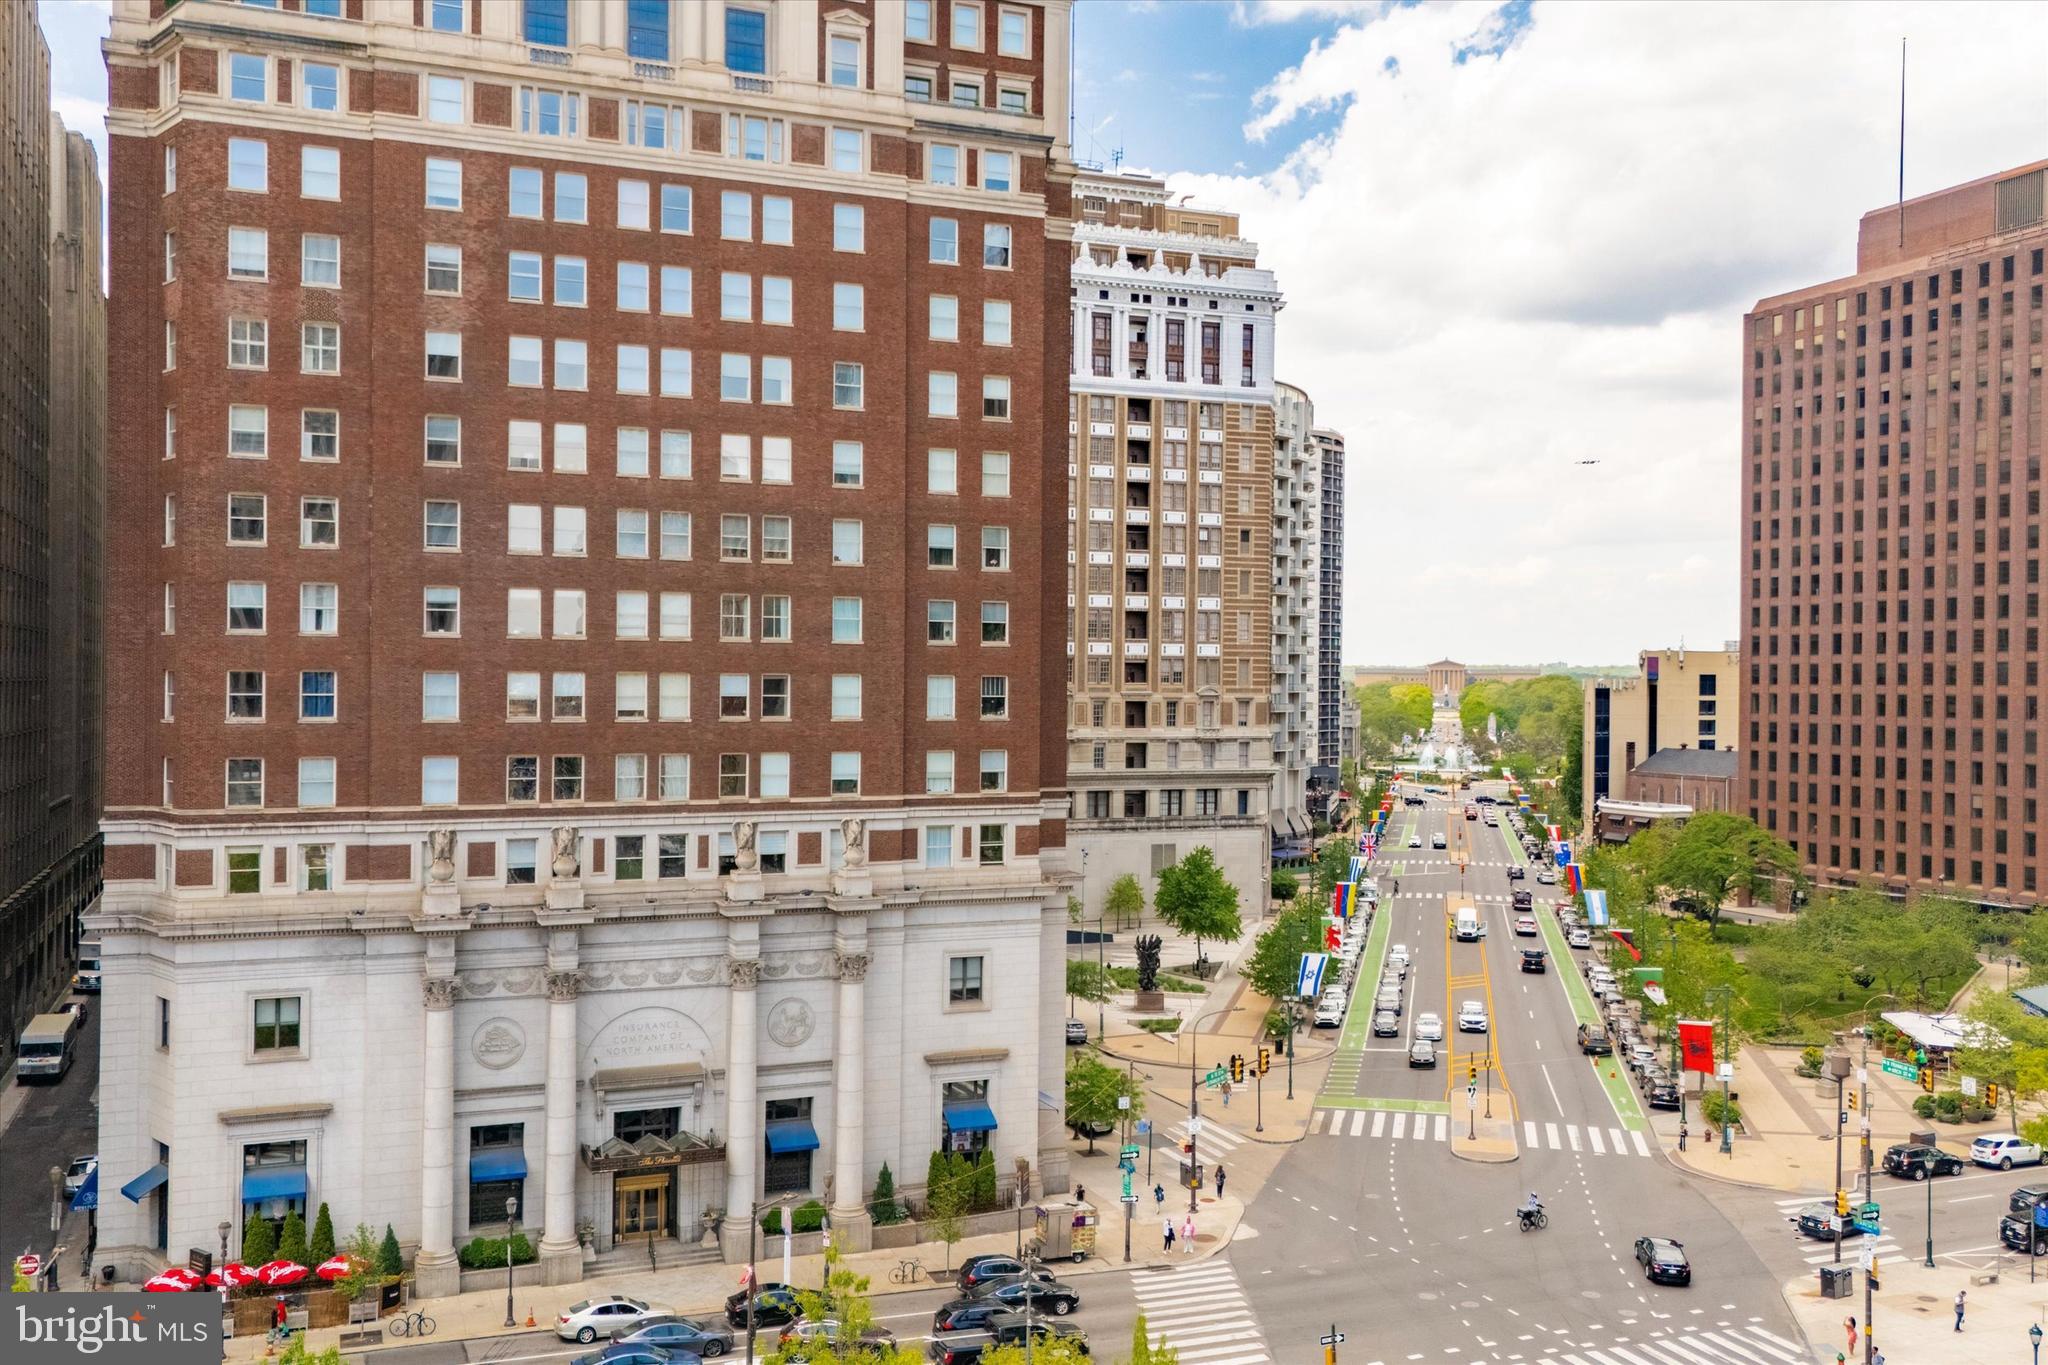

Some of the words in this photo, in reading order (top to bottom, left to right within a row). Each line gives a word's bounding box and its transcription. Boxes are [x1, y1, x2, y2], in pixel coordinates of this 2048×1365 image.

[619, 1020, 680, 1032] INSURANCE
[613, 1032, 665, 1045] COMPANY
[670, 1031, 683, 1040] OF
[606, 1046, 641, 1057] NORTH
[647, 1042, 692, 1053] AMERICA
